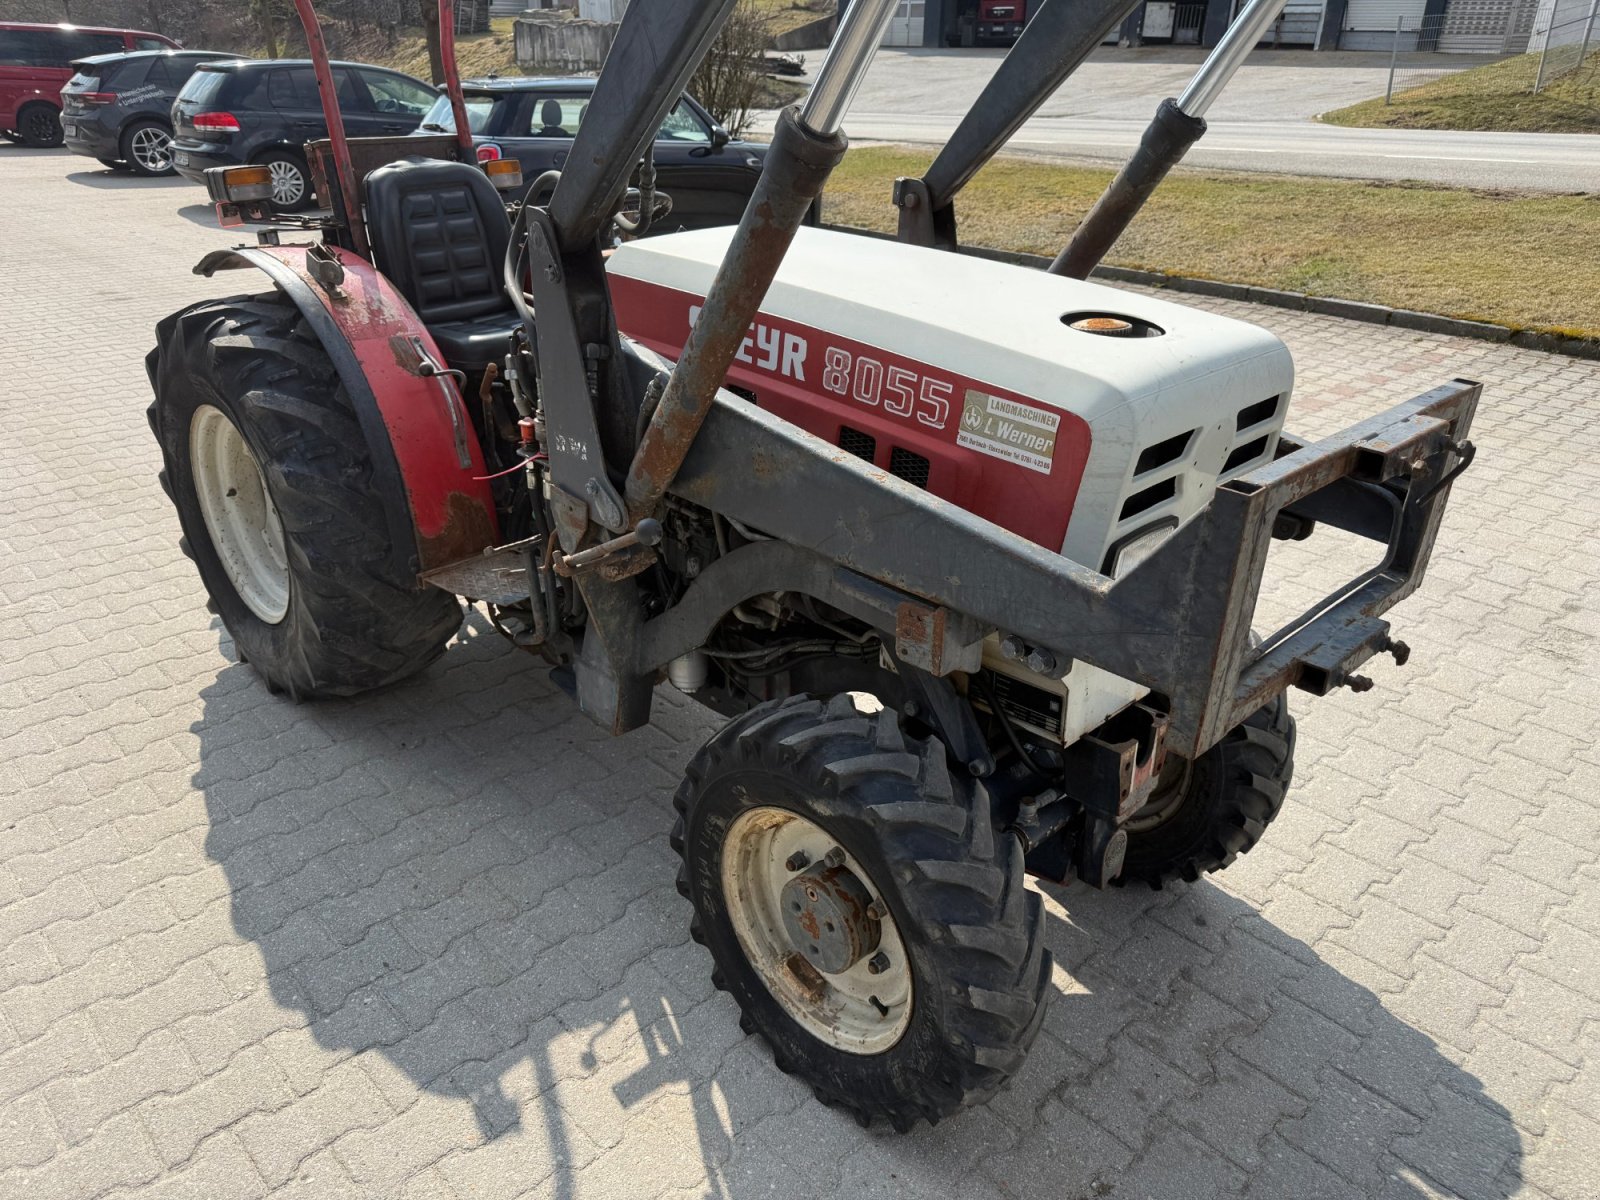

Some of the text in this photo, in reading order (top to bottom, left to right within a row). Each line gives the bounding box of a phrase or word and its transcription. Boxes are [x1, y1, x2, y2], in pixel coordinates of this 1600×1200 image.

[689, 305, 954, 430] EYR 8055
[990, 399, 1057, 428] LANDMASCHINEN
[997, 421, 1053, 452] Werner
